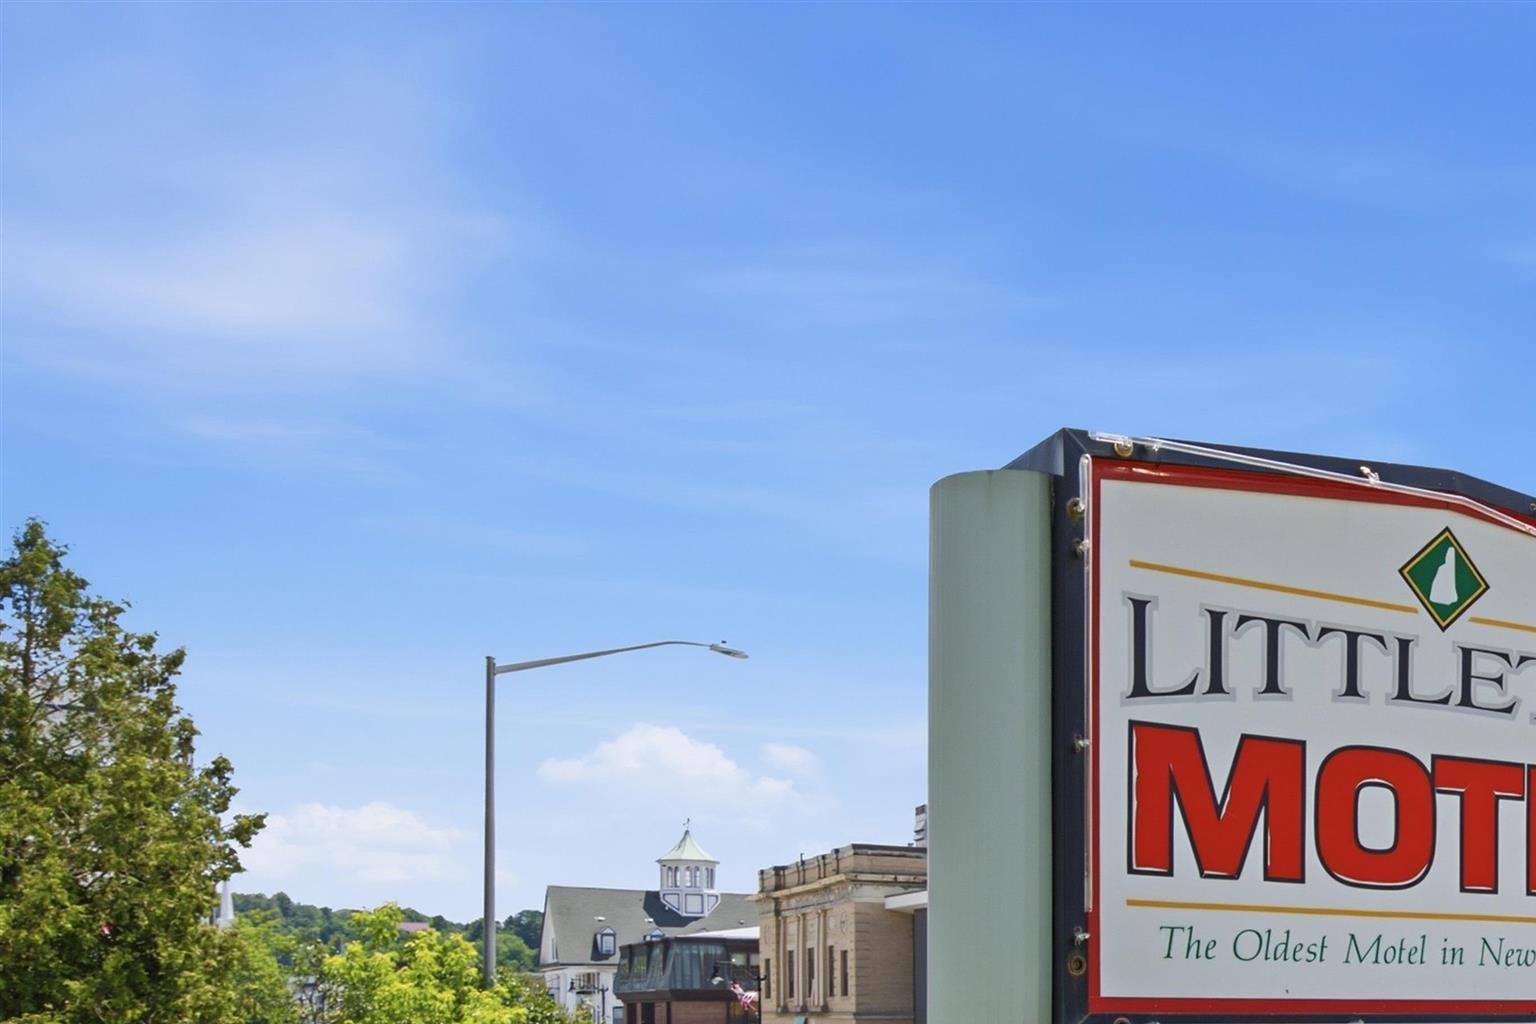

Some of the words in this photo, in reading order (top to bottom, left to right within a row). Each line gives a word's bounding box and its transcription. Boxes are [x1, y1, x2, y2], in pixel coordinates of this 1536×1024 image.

[1159, 925, 1217, 961] The
[1232, 928, 1329, 963] Oldest
[1342, 932, 1427, 965] Motel
[1441, 937, 1465, 966] in
[1477, 936, 1536, 968] New
